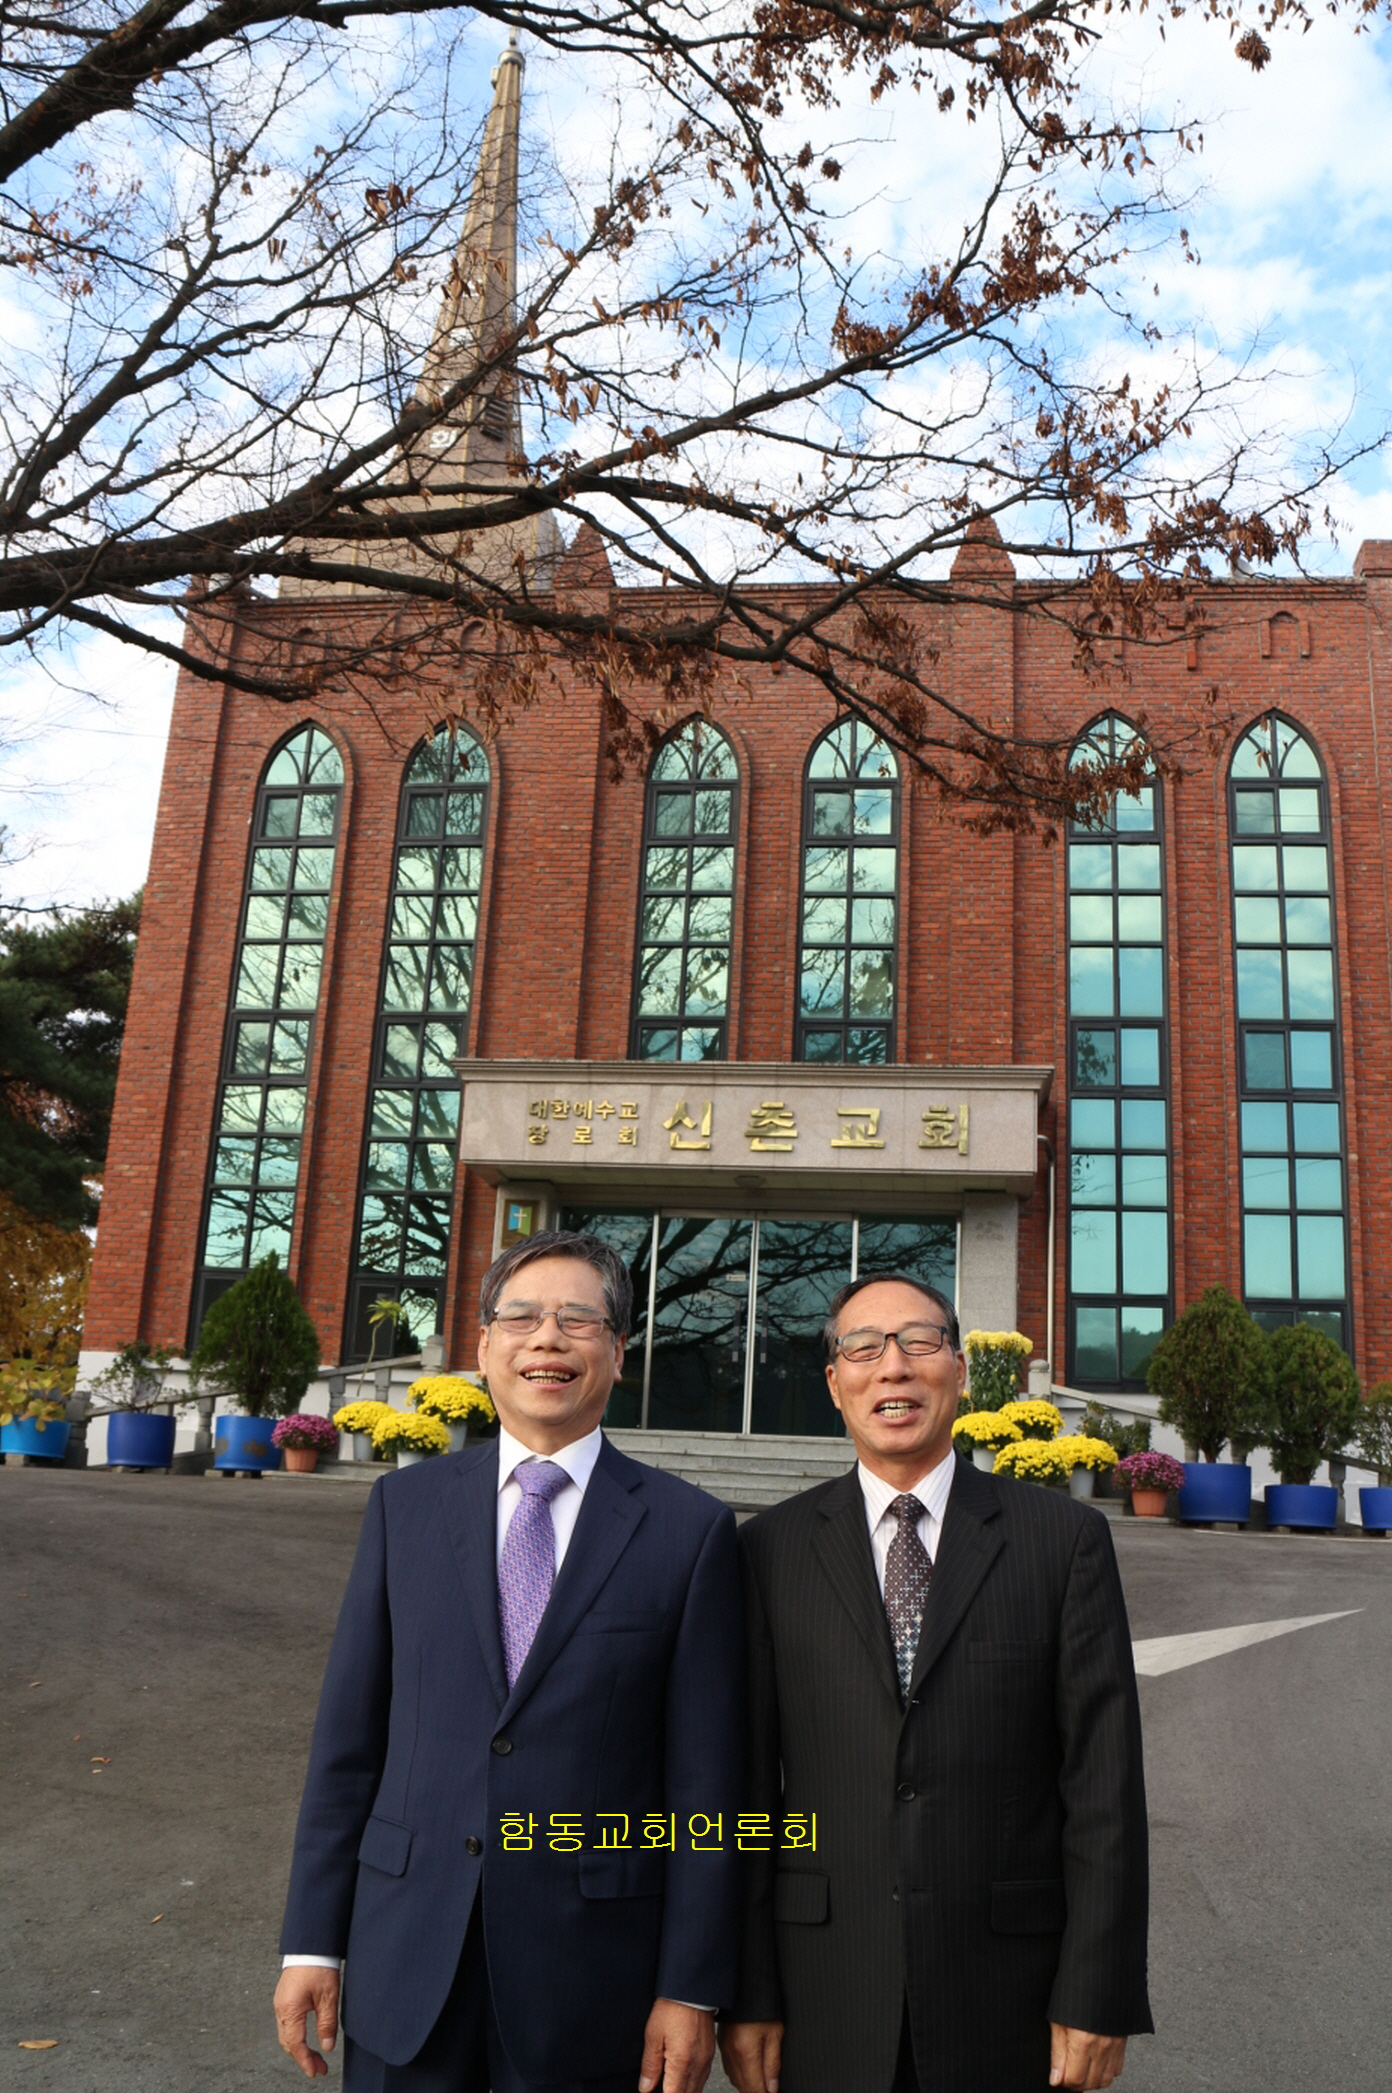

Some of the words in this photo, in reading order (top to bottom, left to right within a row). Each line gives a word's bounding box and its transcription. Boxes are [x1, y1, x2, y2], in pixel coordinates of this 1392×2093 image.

[529, 1099, 640, 1120] 대한예수교
[528, 1124, 638, 1146] 장로회
[663, 1101, 969, 1154] 신촌교회
